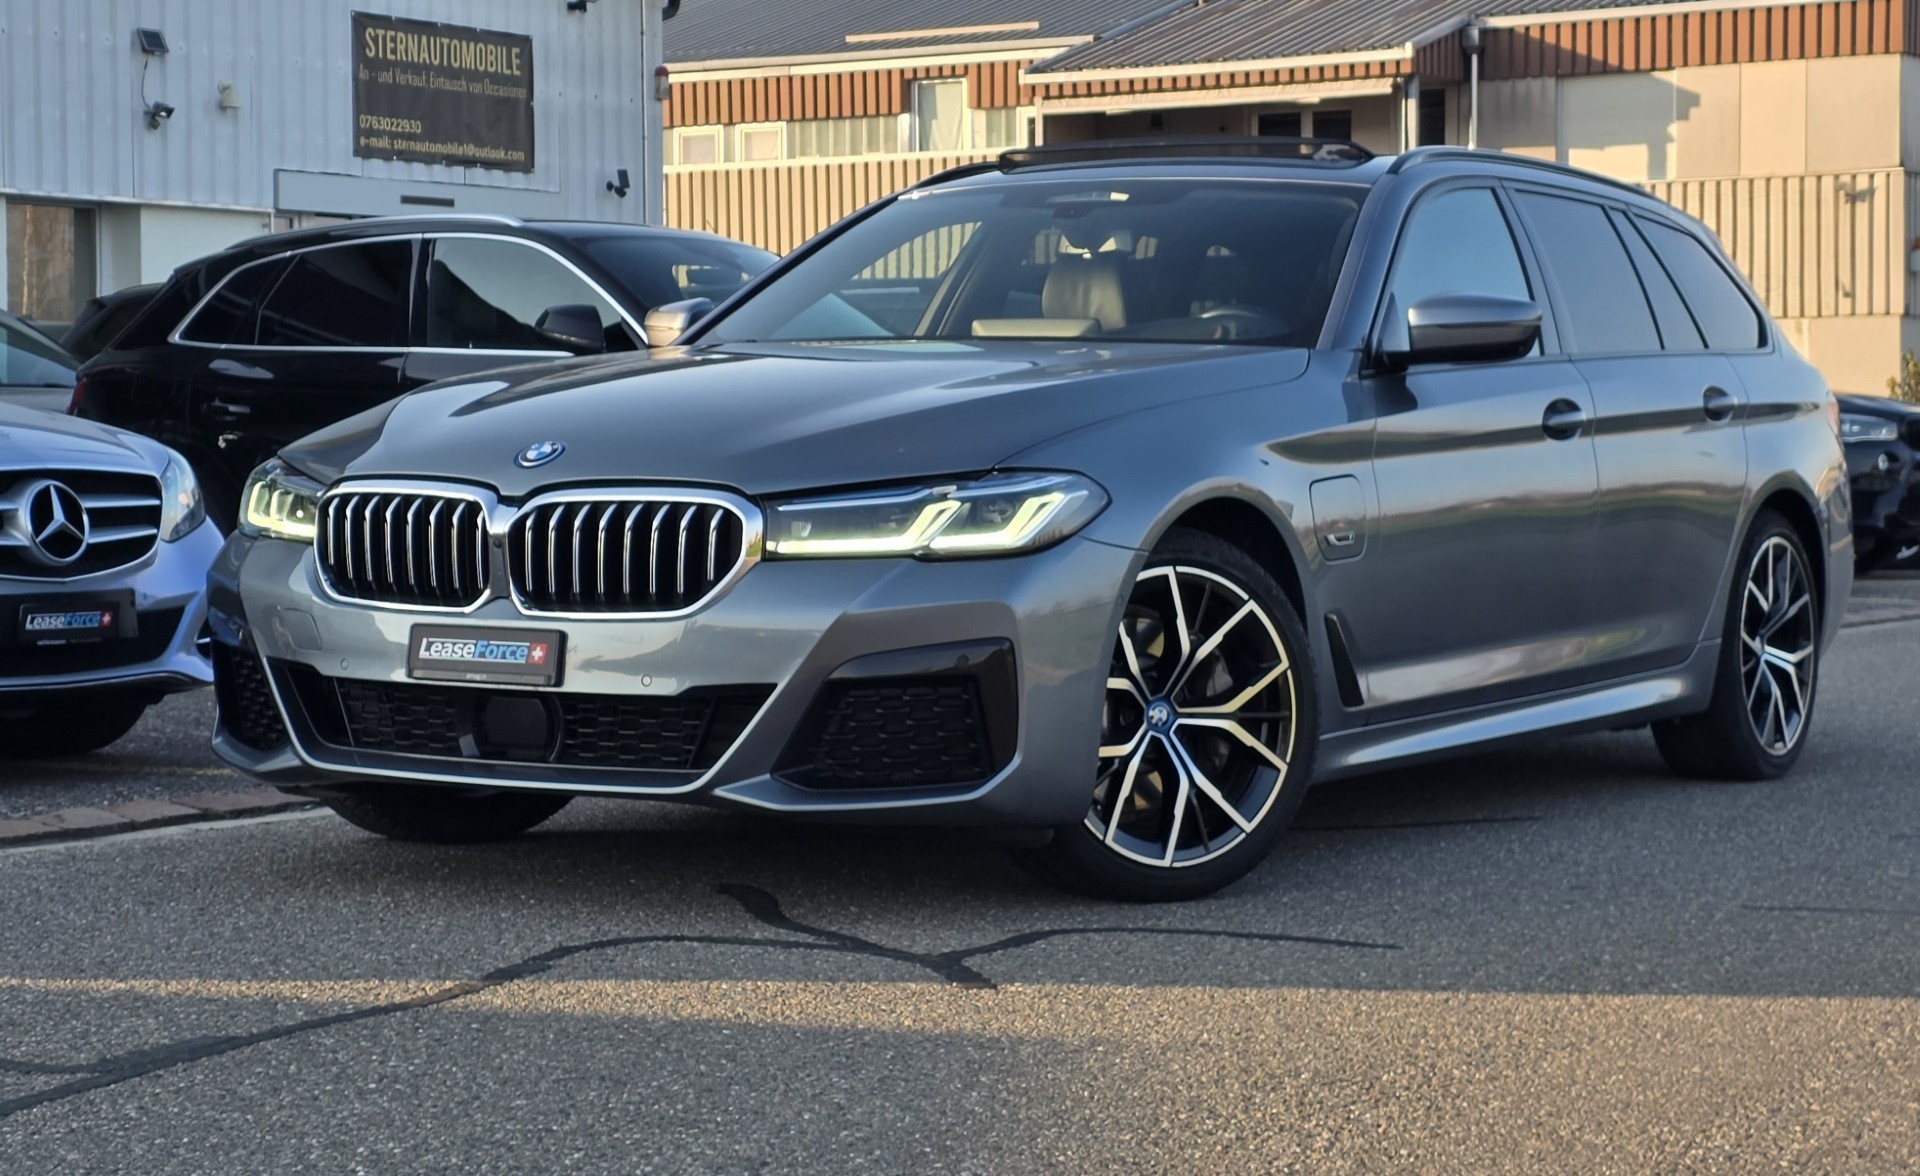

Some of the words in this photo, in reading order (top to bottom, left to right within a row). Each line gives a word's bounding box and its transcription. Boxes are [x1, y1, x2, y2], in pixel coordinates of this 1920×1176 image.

[365, 27, 521, 76] STERNAUTOMOBILE
[359, 63, 369, 80] An
[378, 67, 393, 84] und
[430, 71, 467, 92] Eintausch
[468, 82, 483, 94] von
[484, 78, 527, 98] Occasionen
[359, 114, 422, 134] 0763022930
[360, 134, 392, 149] e-mail:
[393, 139, 525, 161] sternautomobile1@outlook.com
[25, 611, 101, 630] LeaseForce
[418, 637, 530, 664] LeaseForce
